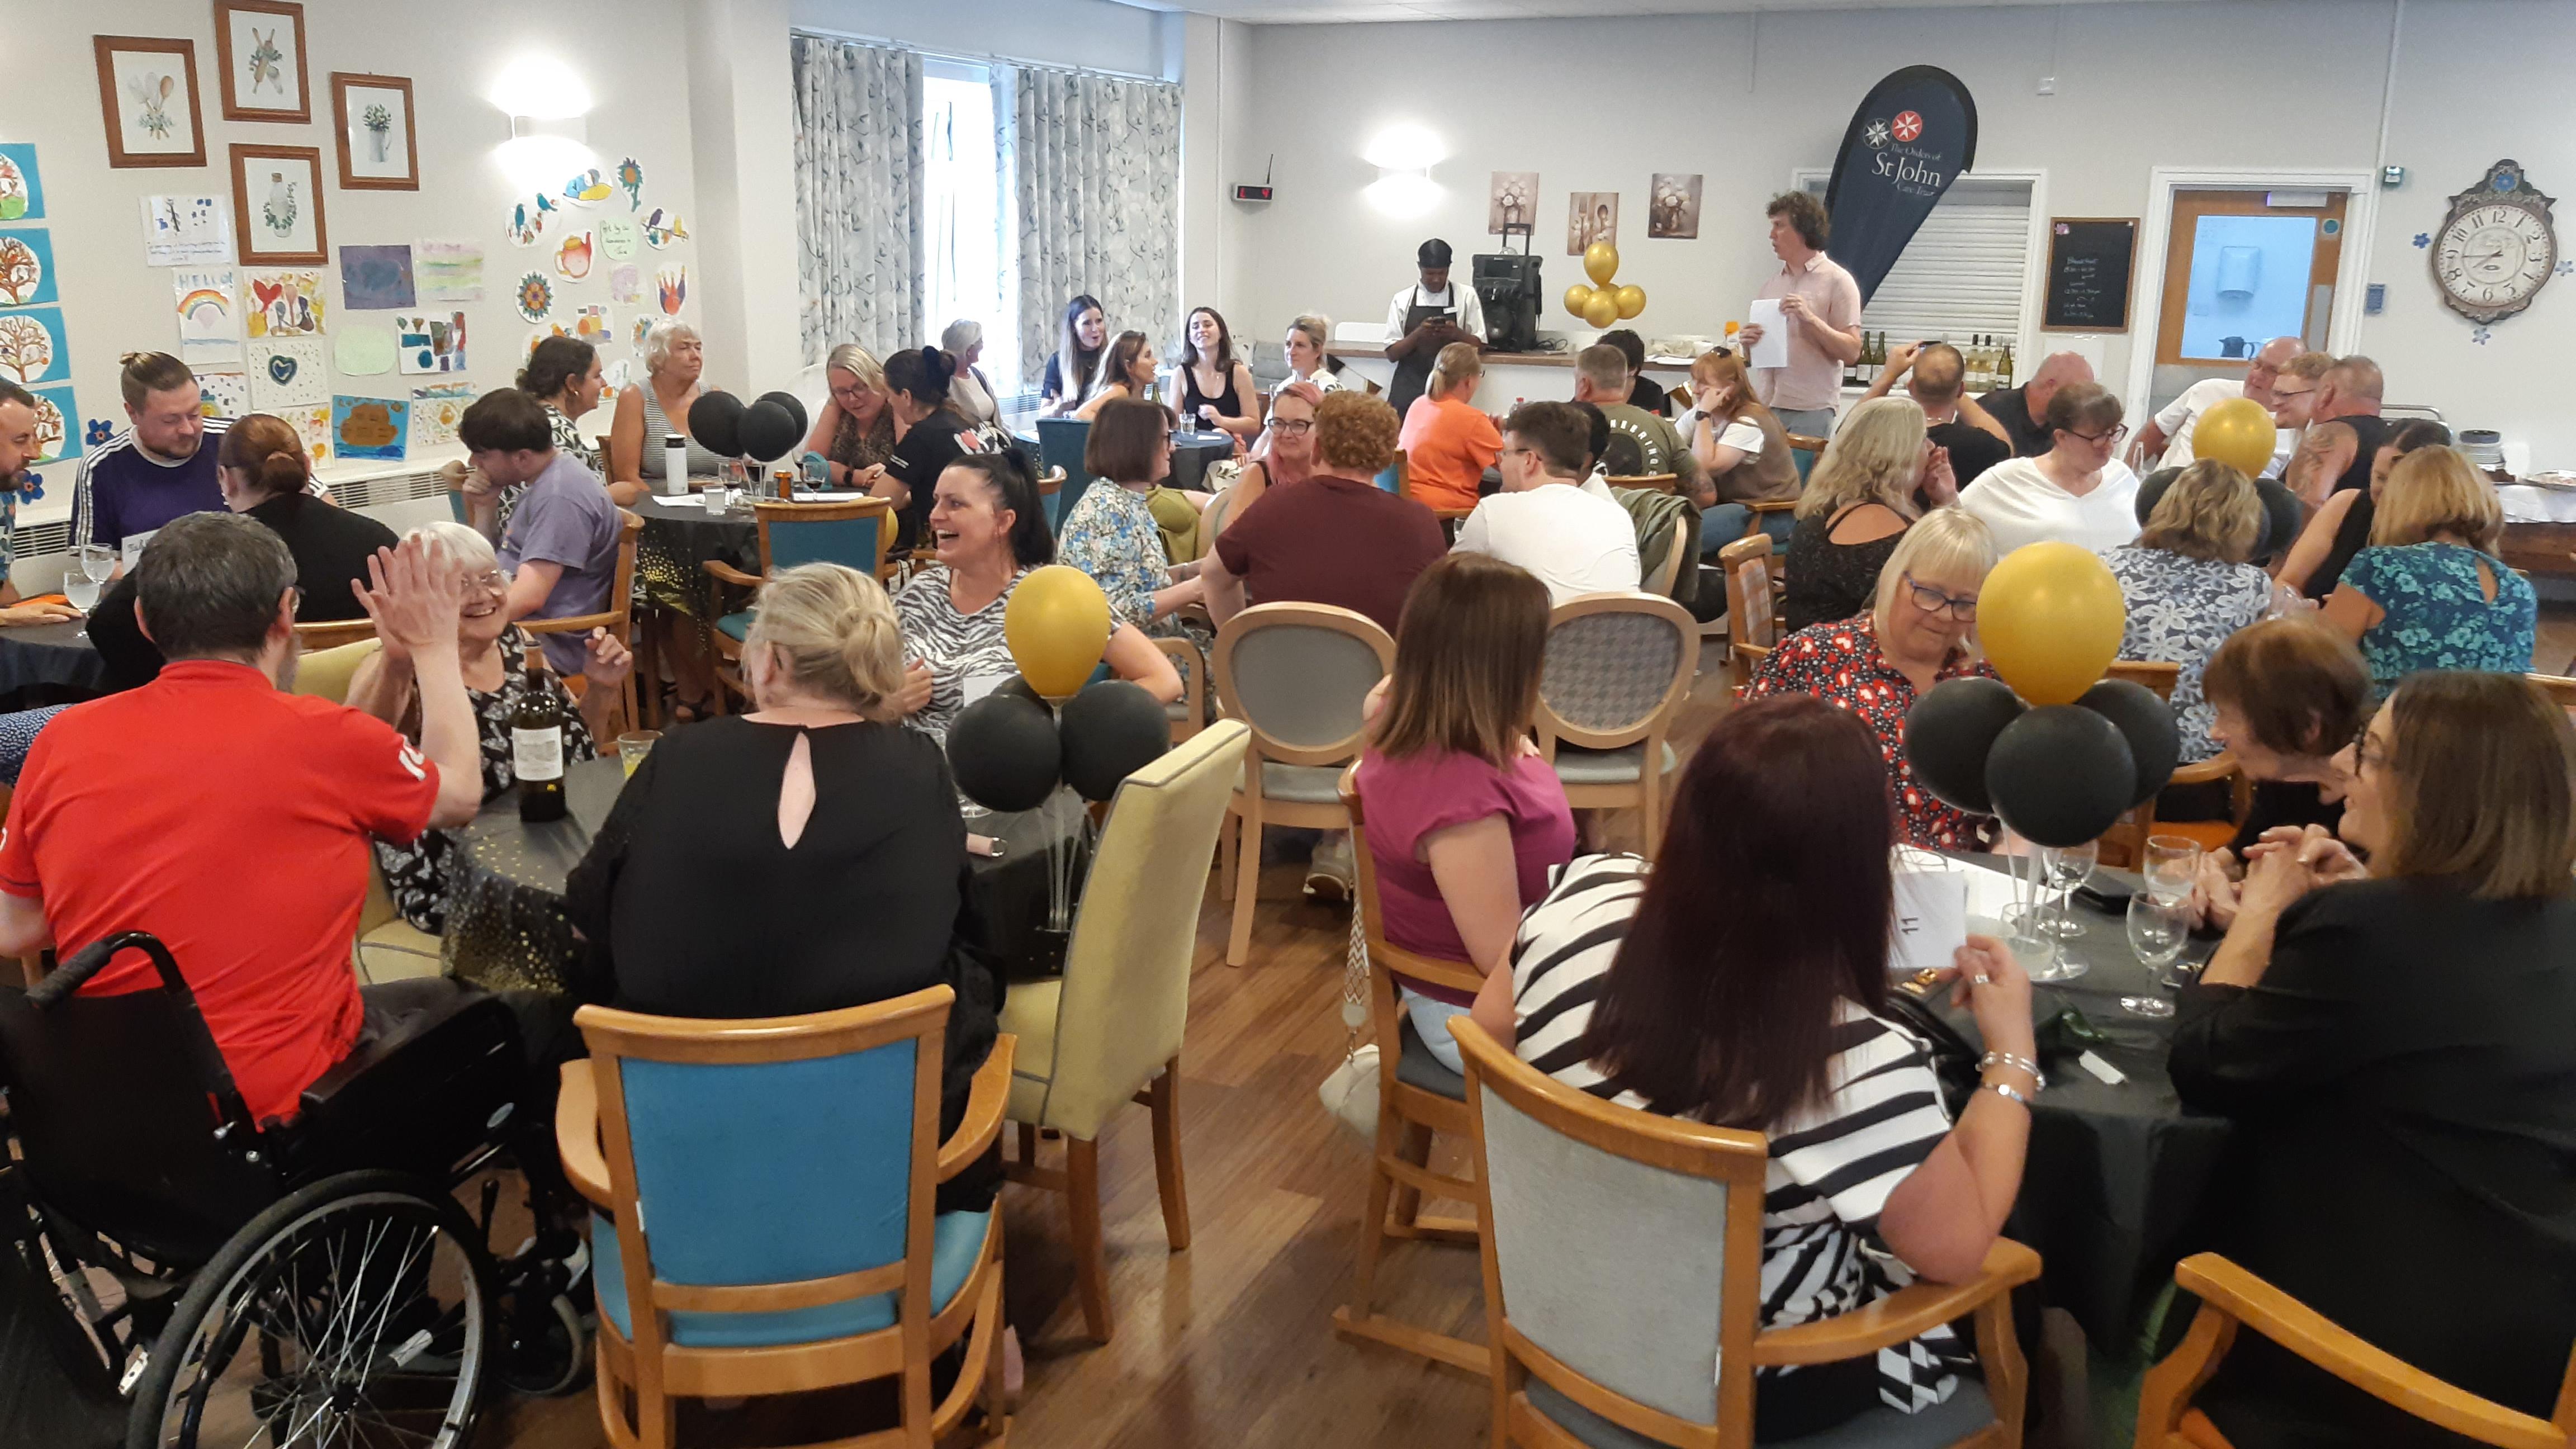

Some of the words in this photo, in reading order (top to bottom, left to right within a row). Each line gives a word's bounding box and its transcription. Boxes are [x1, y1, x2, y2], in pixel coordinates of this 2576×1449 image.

[1872, 152, 1895, 177] St
[1892, 157, 1940, 187] John
[2492, 210, 2507, 224] 12
[2526, 232, 2541, 244] 2
[2446, 267, 2463, 281] 8
[2482, 288, 2494, 301] 6
[1901, 917, 1919, 935] 11
